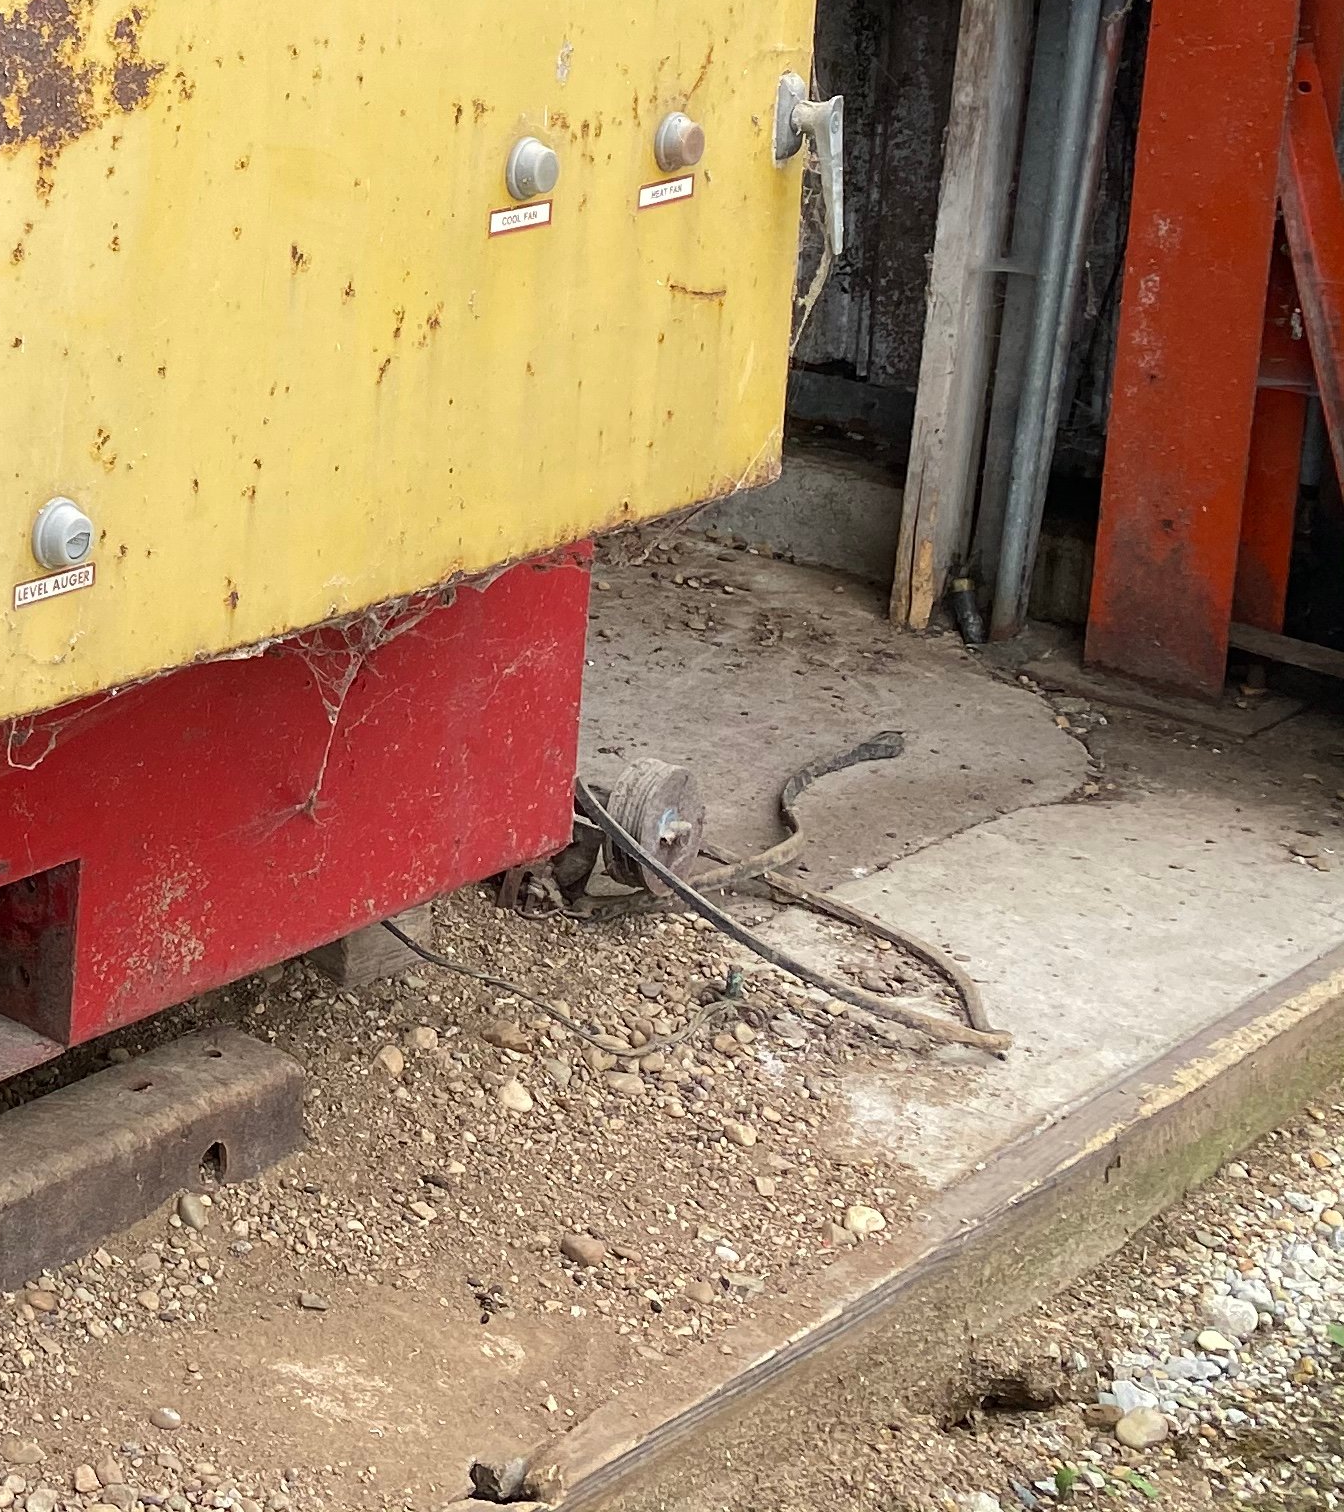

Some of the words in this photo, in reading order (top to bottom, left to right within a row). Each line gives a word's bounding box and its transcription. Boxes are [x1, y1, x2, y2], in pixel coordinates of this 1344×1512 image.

[651, 188, 668, 199] HEAT
[669, 184, 683, 195] FAN
[502, 213, 522, 226] COOL
[523, 210, 538, 221] FAN
[17, 582, 49, 602] LEVEL
[52, 570, 90, 591] AUGER
